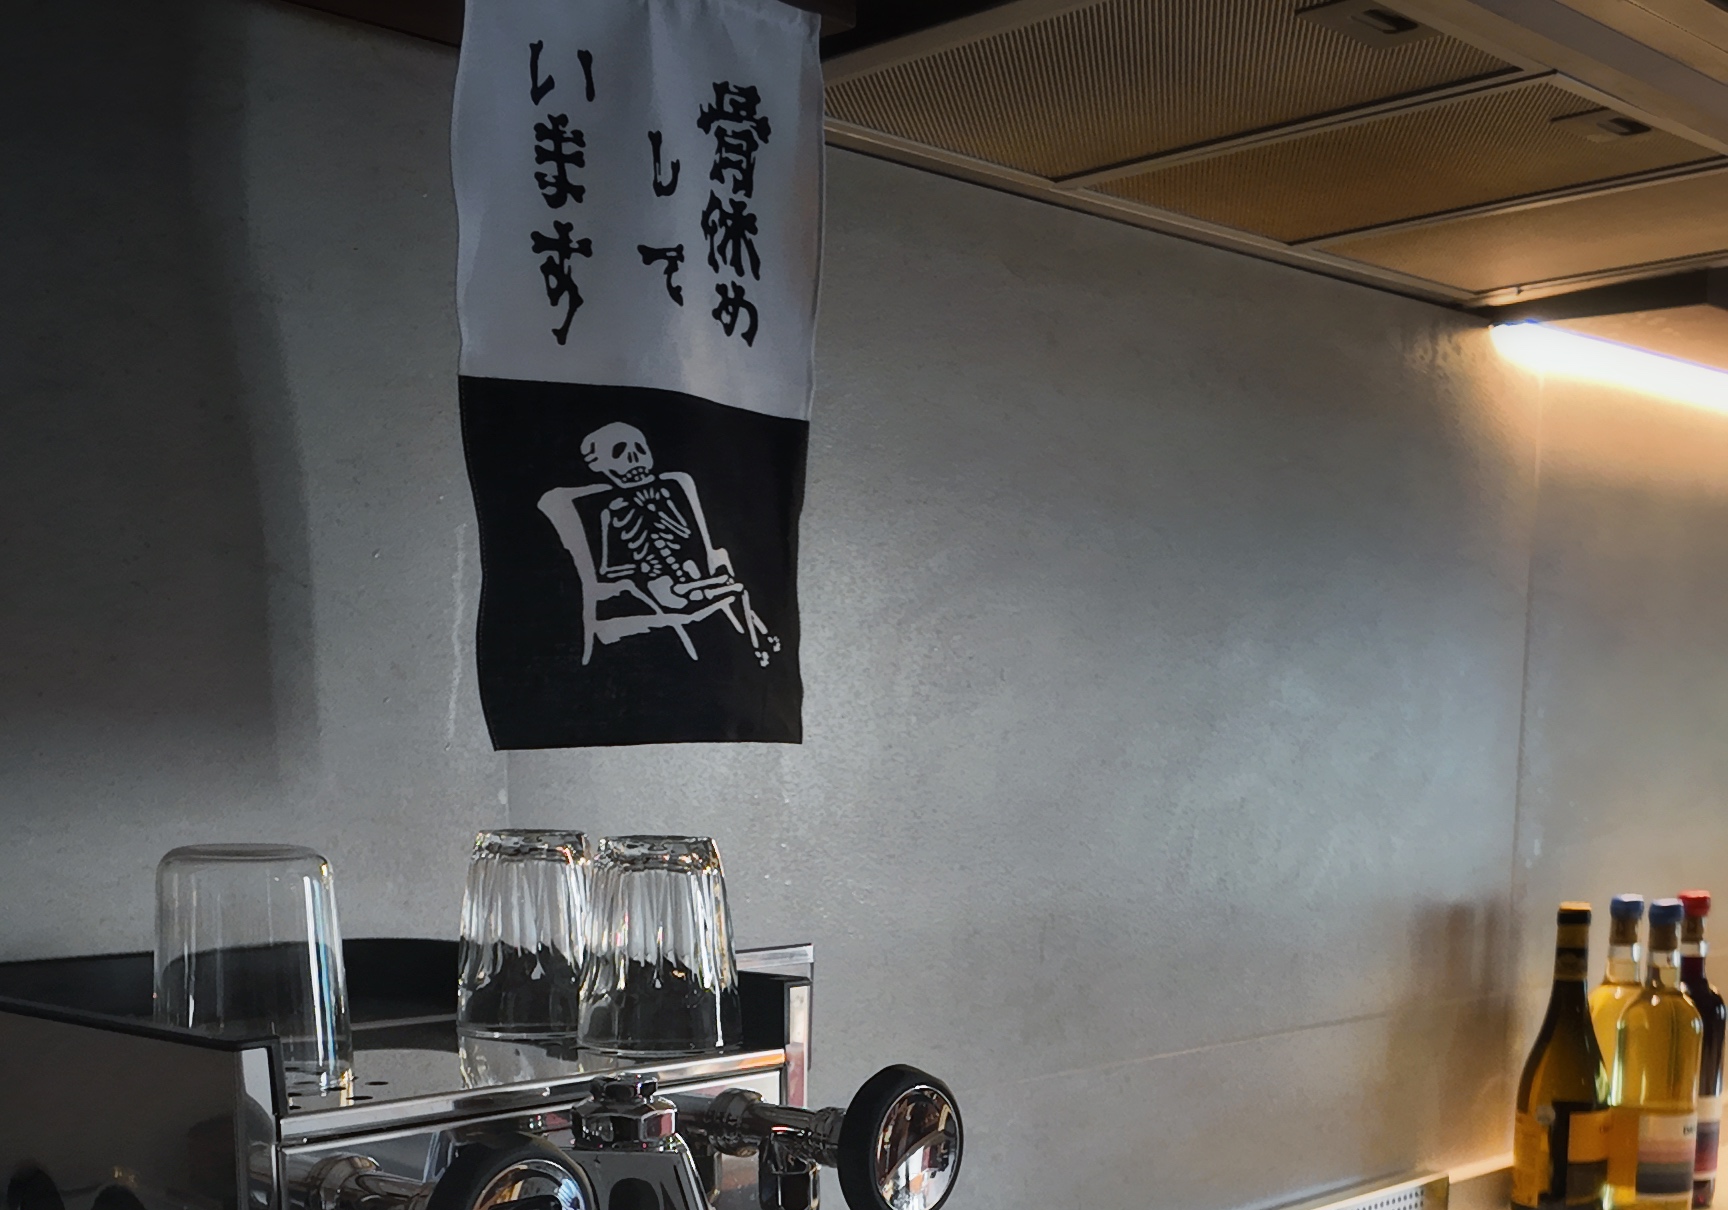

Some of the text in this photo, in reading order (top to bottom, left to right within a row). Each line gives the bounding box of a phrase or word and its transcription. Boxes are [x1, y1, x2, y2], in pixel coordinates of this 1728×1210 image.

[529, 40, 595, 345] います
[637, 130, 685, 306] して
[697, 81, 771, 347] 骨休め
